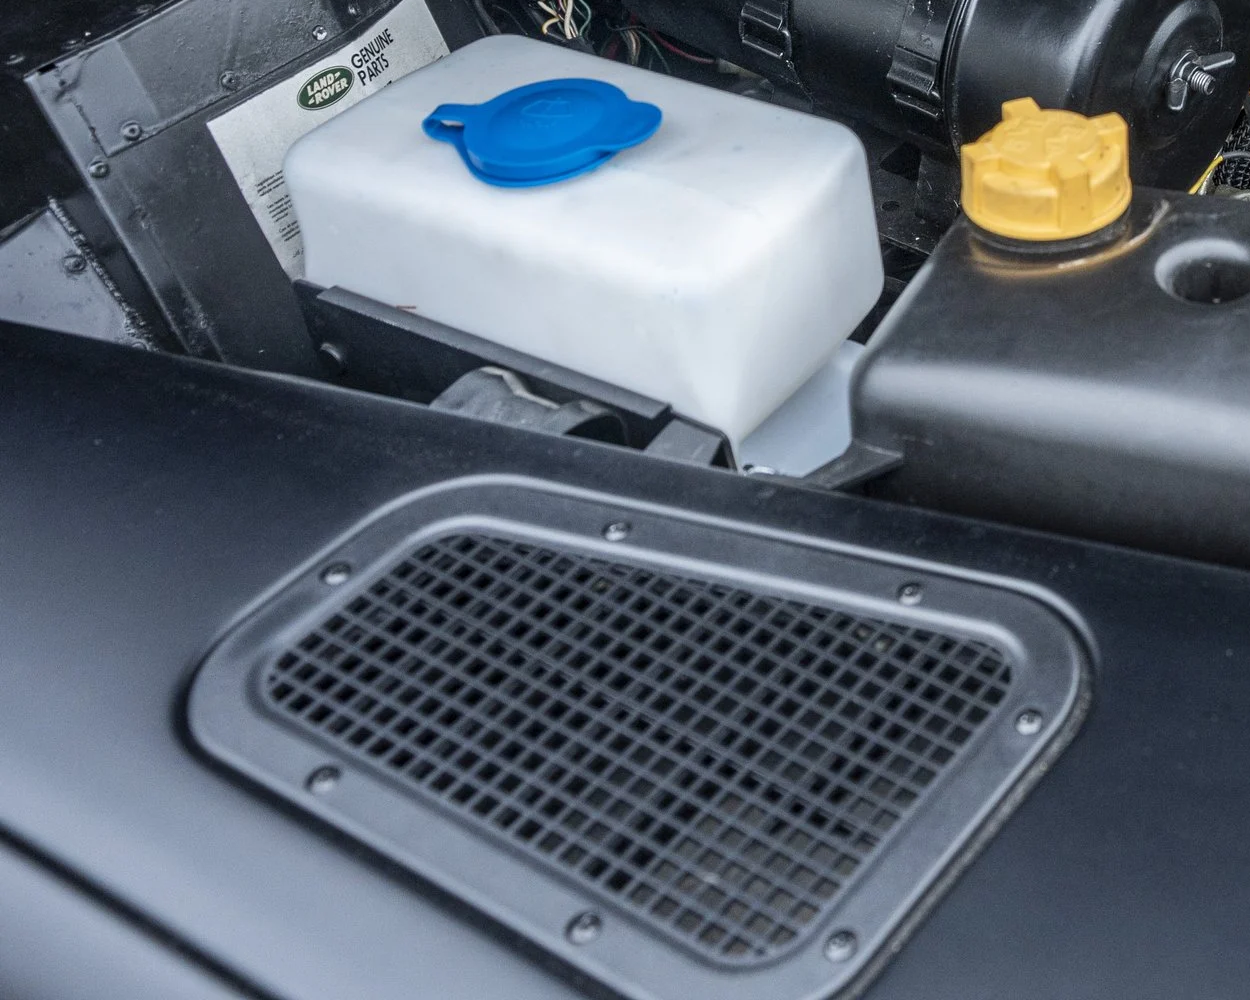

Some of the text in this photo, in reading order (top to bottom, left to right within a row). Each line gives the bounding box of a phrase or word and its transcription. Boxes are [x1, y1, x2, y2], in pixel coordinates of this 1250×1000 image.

[351, 28, 394, 69] GENUINE
[307, 73, 336, 97] LAND
[357, 53, 389, 87] PARTS
[314, 78, 348, 105] ROVER
